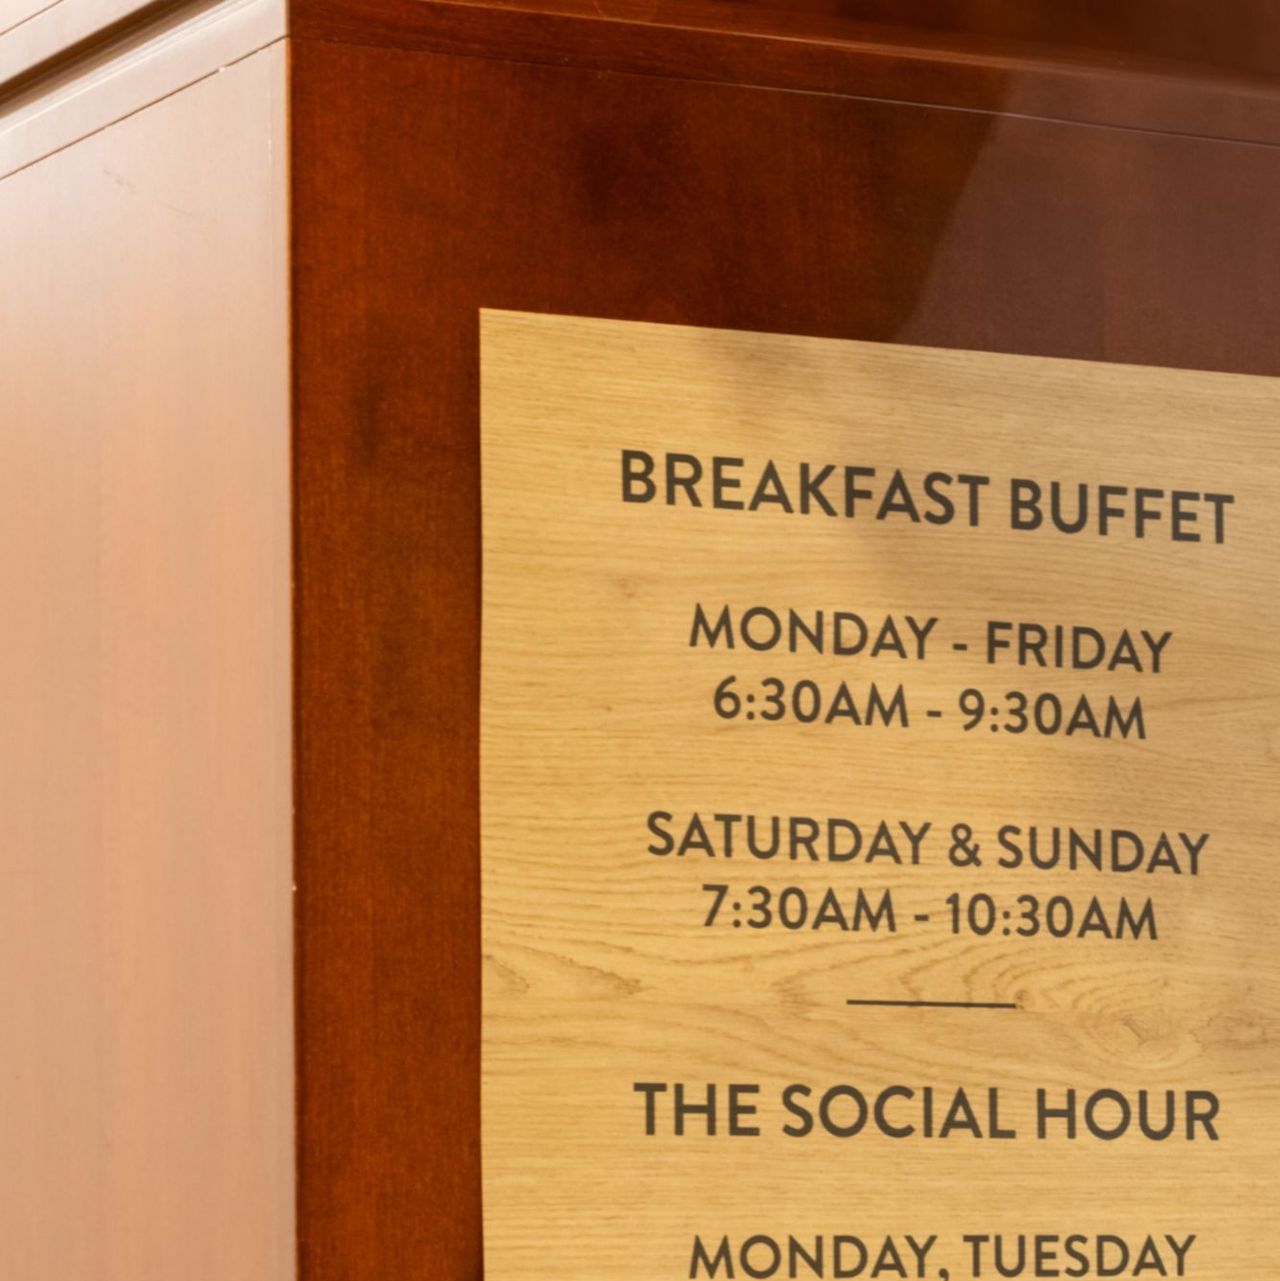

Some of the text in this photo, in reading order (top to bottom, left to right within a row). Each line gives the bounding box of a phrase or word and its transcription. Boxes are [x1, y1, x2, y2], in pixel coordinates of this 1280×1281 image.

[620, 448, 1236, 545] BREAKFAST BUFFET
[688, 602, 1173, 675] MONDAY - FRIDAY
[712, 674, 1147, 741] 6:30AM - 9:30AM
[646, 809, 1211, 877] SATURDAY & SUNDAY
[701, 882, 1159, 941] 7:30AM - 10:30AM
[632, 1081, 1221, 1142] THE SOCIAL HOUR
[962, 1233, 1198, 1279] TUESDAY
